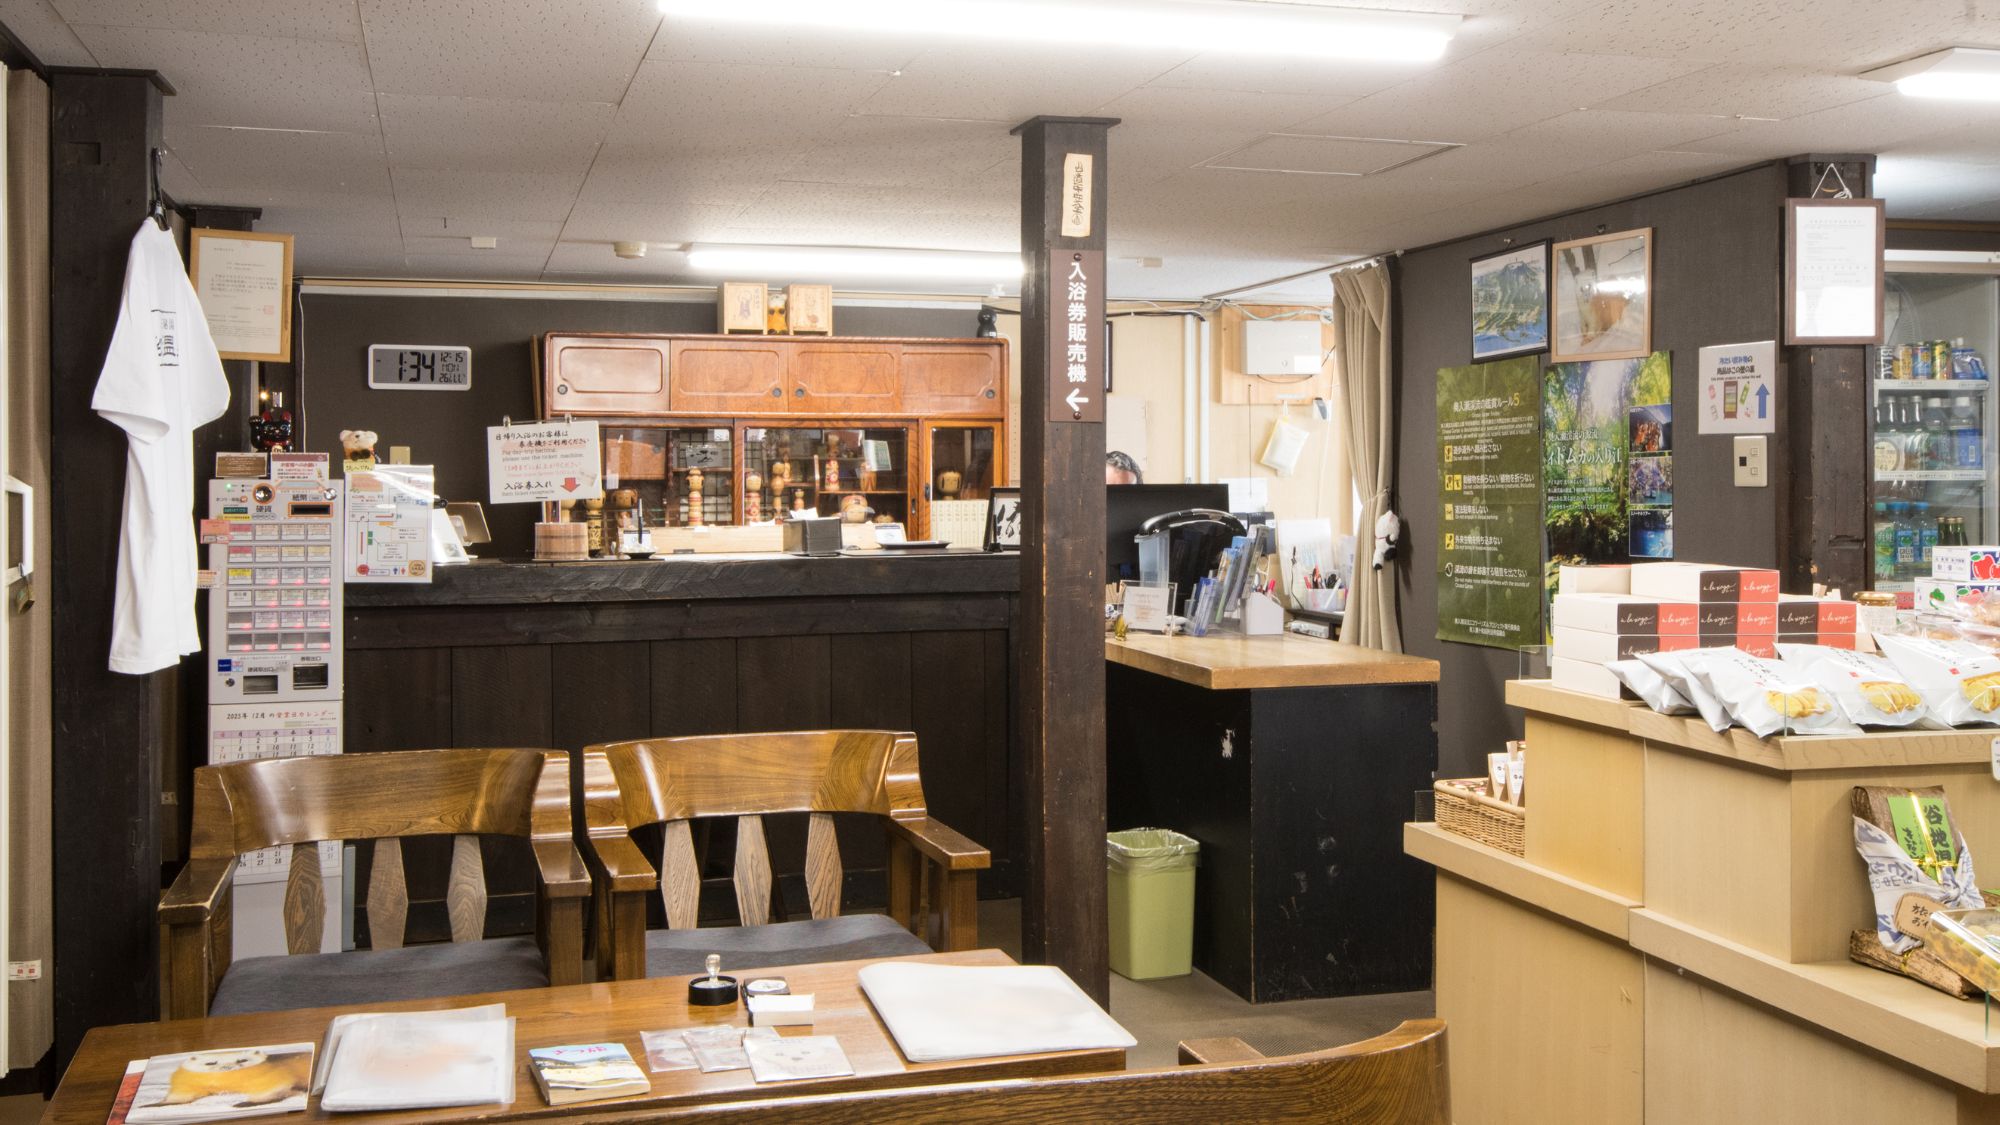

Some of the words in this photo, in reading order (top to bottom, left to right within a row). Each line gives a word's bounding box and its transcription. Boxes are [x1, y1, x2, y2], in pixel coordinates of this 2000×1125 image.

[1067, 261, 1088, 383] 入浴券販売機
[398, 351, 436, 382] 1:34
[496, 430, 569, 441] 日帰り入浴のお客様は
[504, 480, 553, 491] 入浴券入れ
